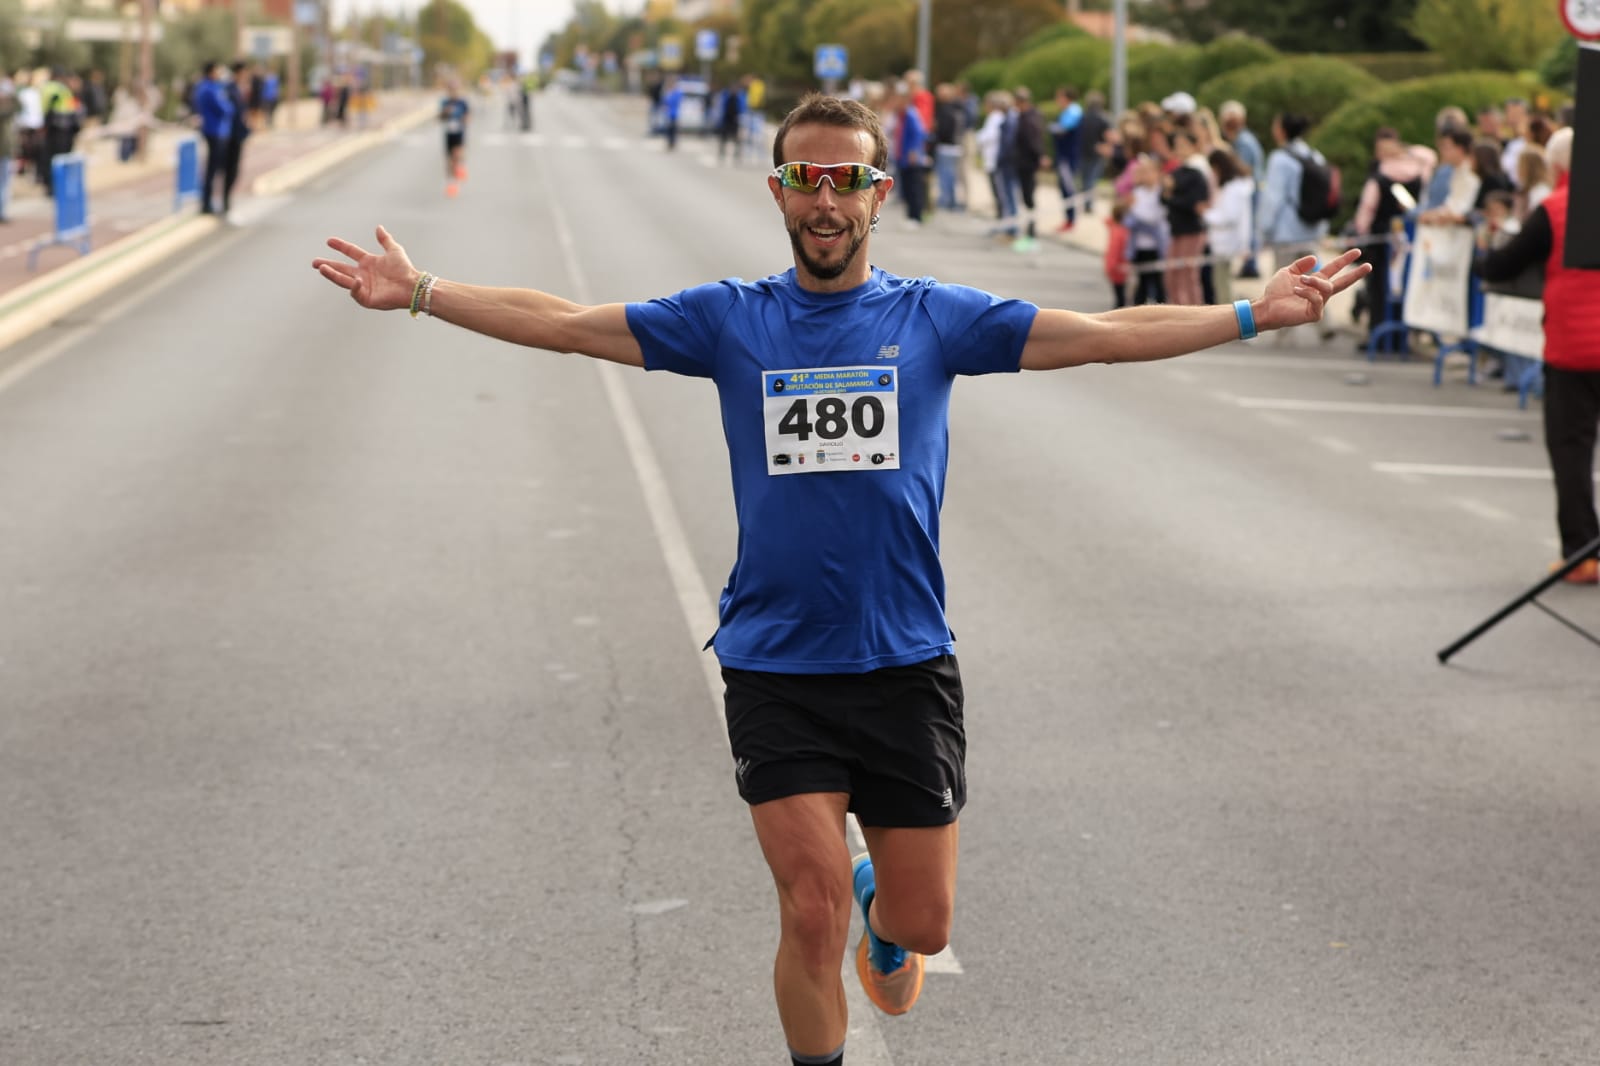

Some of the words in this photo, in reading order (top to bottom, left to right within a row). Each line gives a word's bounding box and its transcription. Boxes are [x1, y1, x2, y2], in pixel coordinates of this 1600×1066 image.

[836, 370, 869, 379] MARATÓN
[785, 382, 823, 391] DIPUTACIÓN
[834, 380, 875, 389] SALAMANCA
[778, 394, 885, 441] 480
